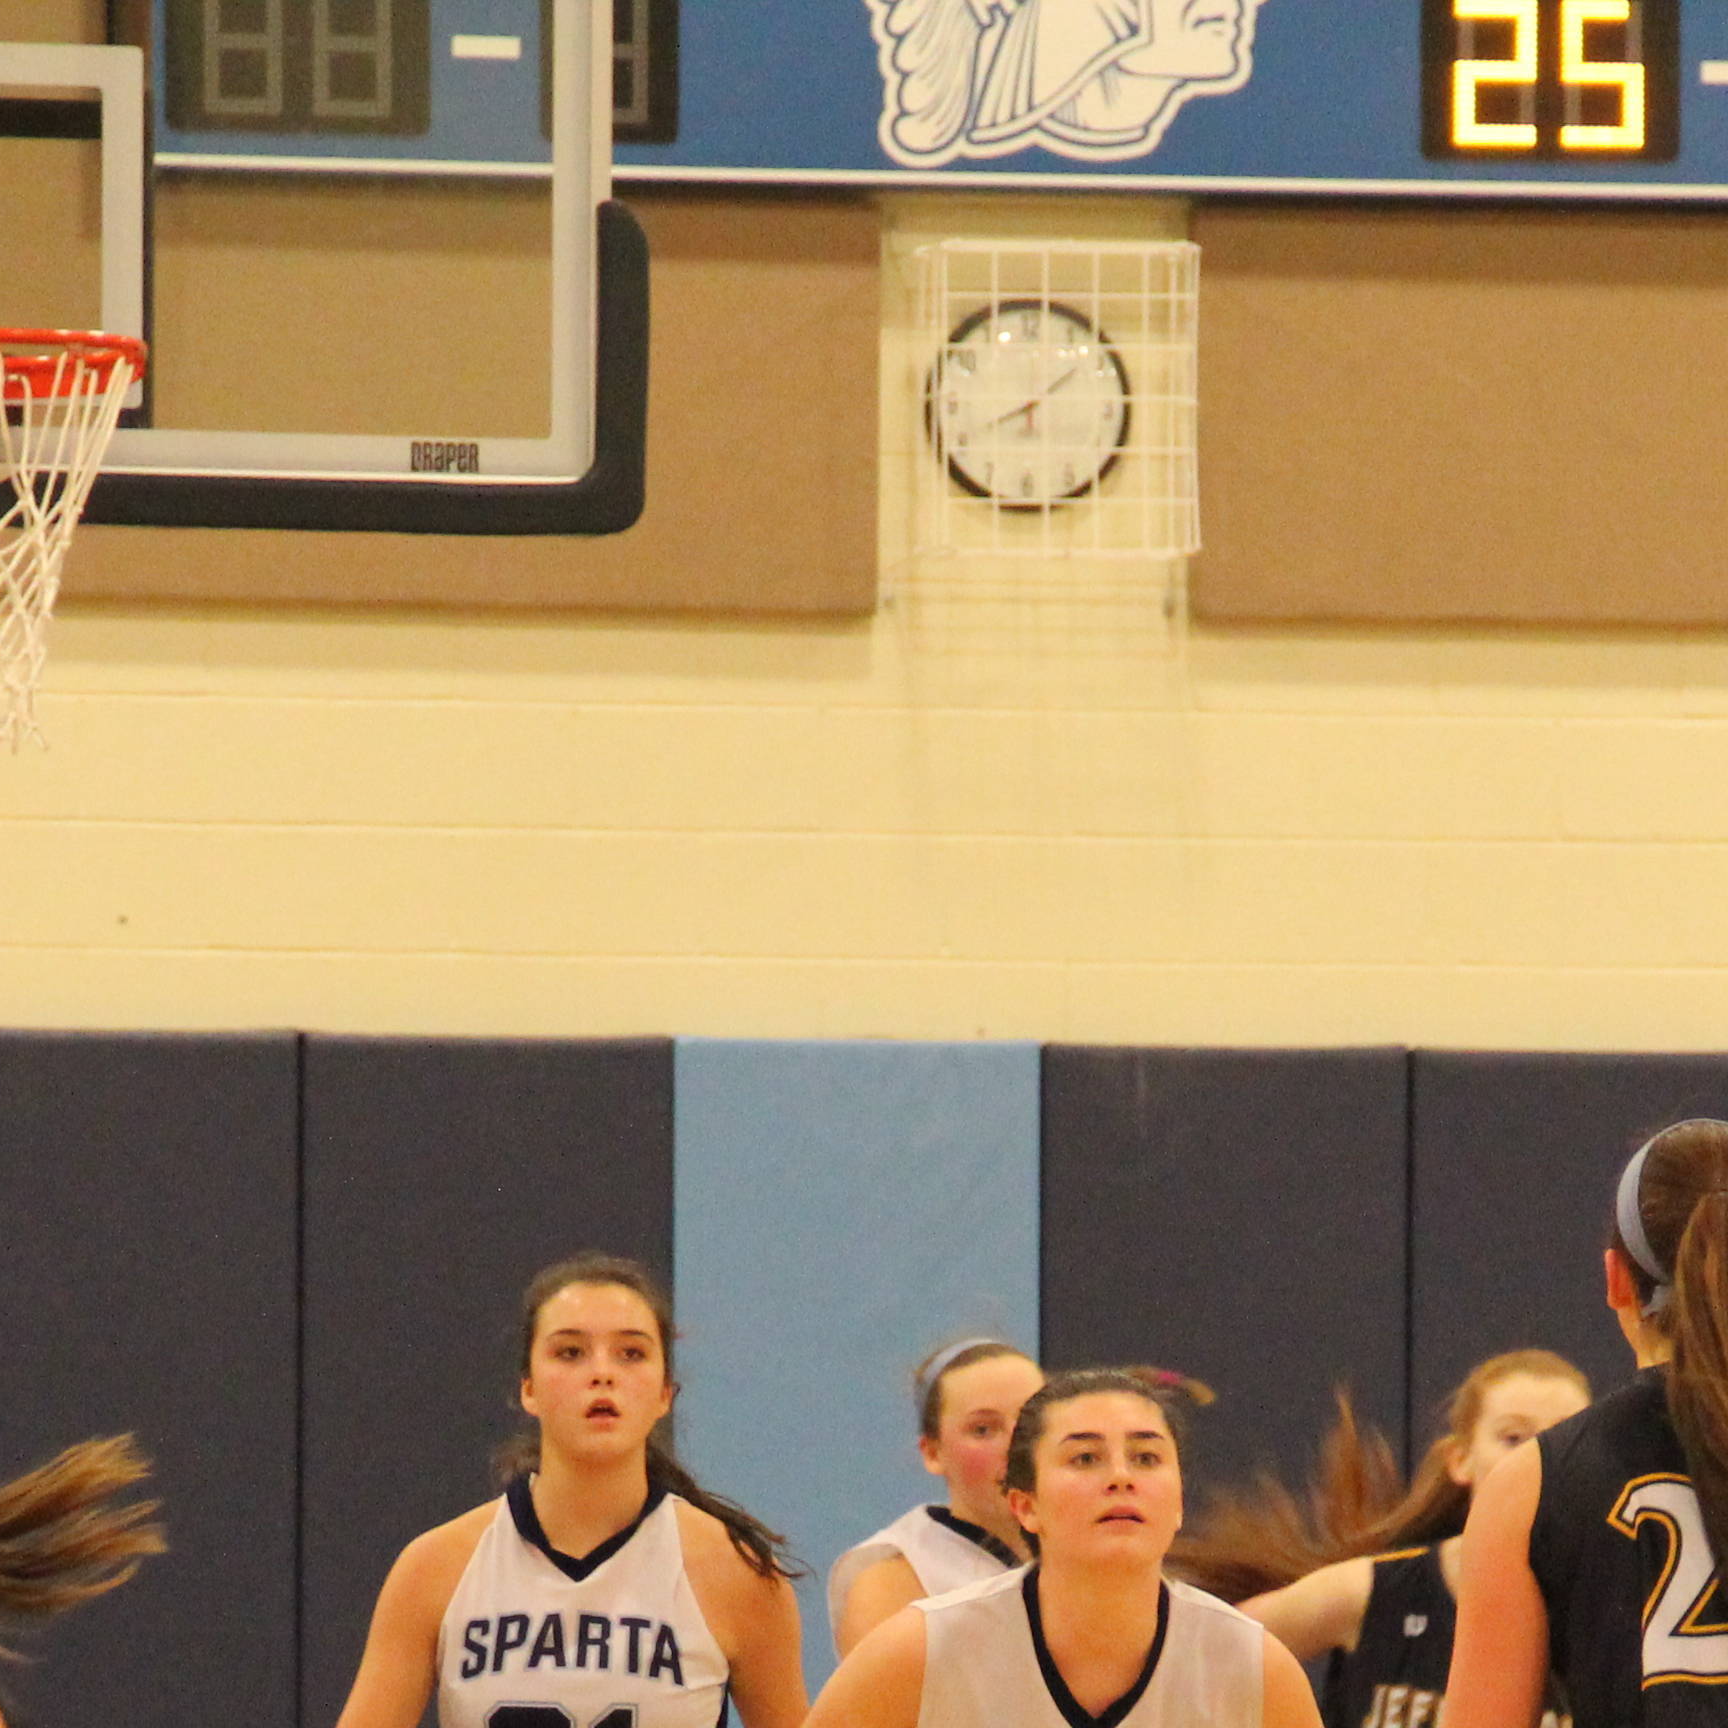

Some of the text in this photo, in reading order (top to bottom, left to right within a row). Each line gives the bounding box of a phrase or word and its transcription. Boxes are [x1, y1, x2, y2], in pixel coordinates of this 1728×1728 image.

[1452, 0, 1645, 148] 25
[411, 441, 479, 472] DRAPER
[461, 1611, 685, 1687] SPARTA
